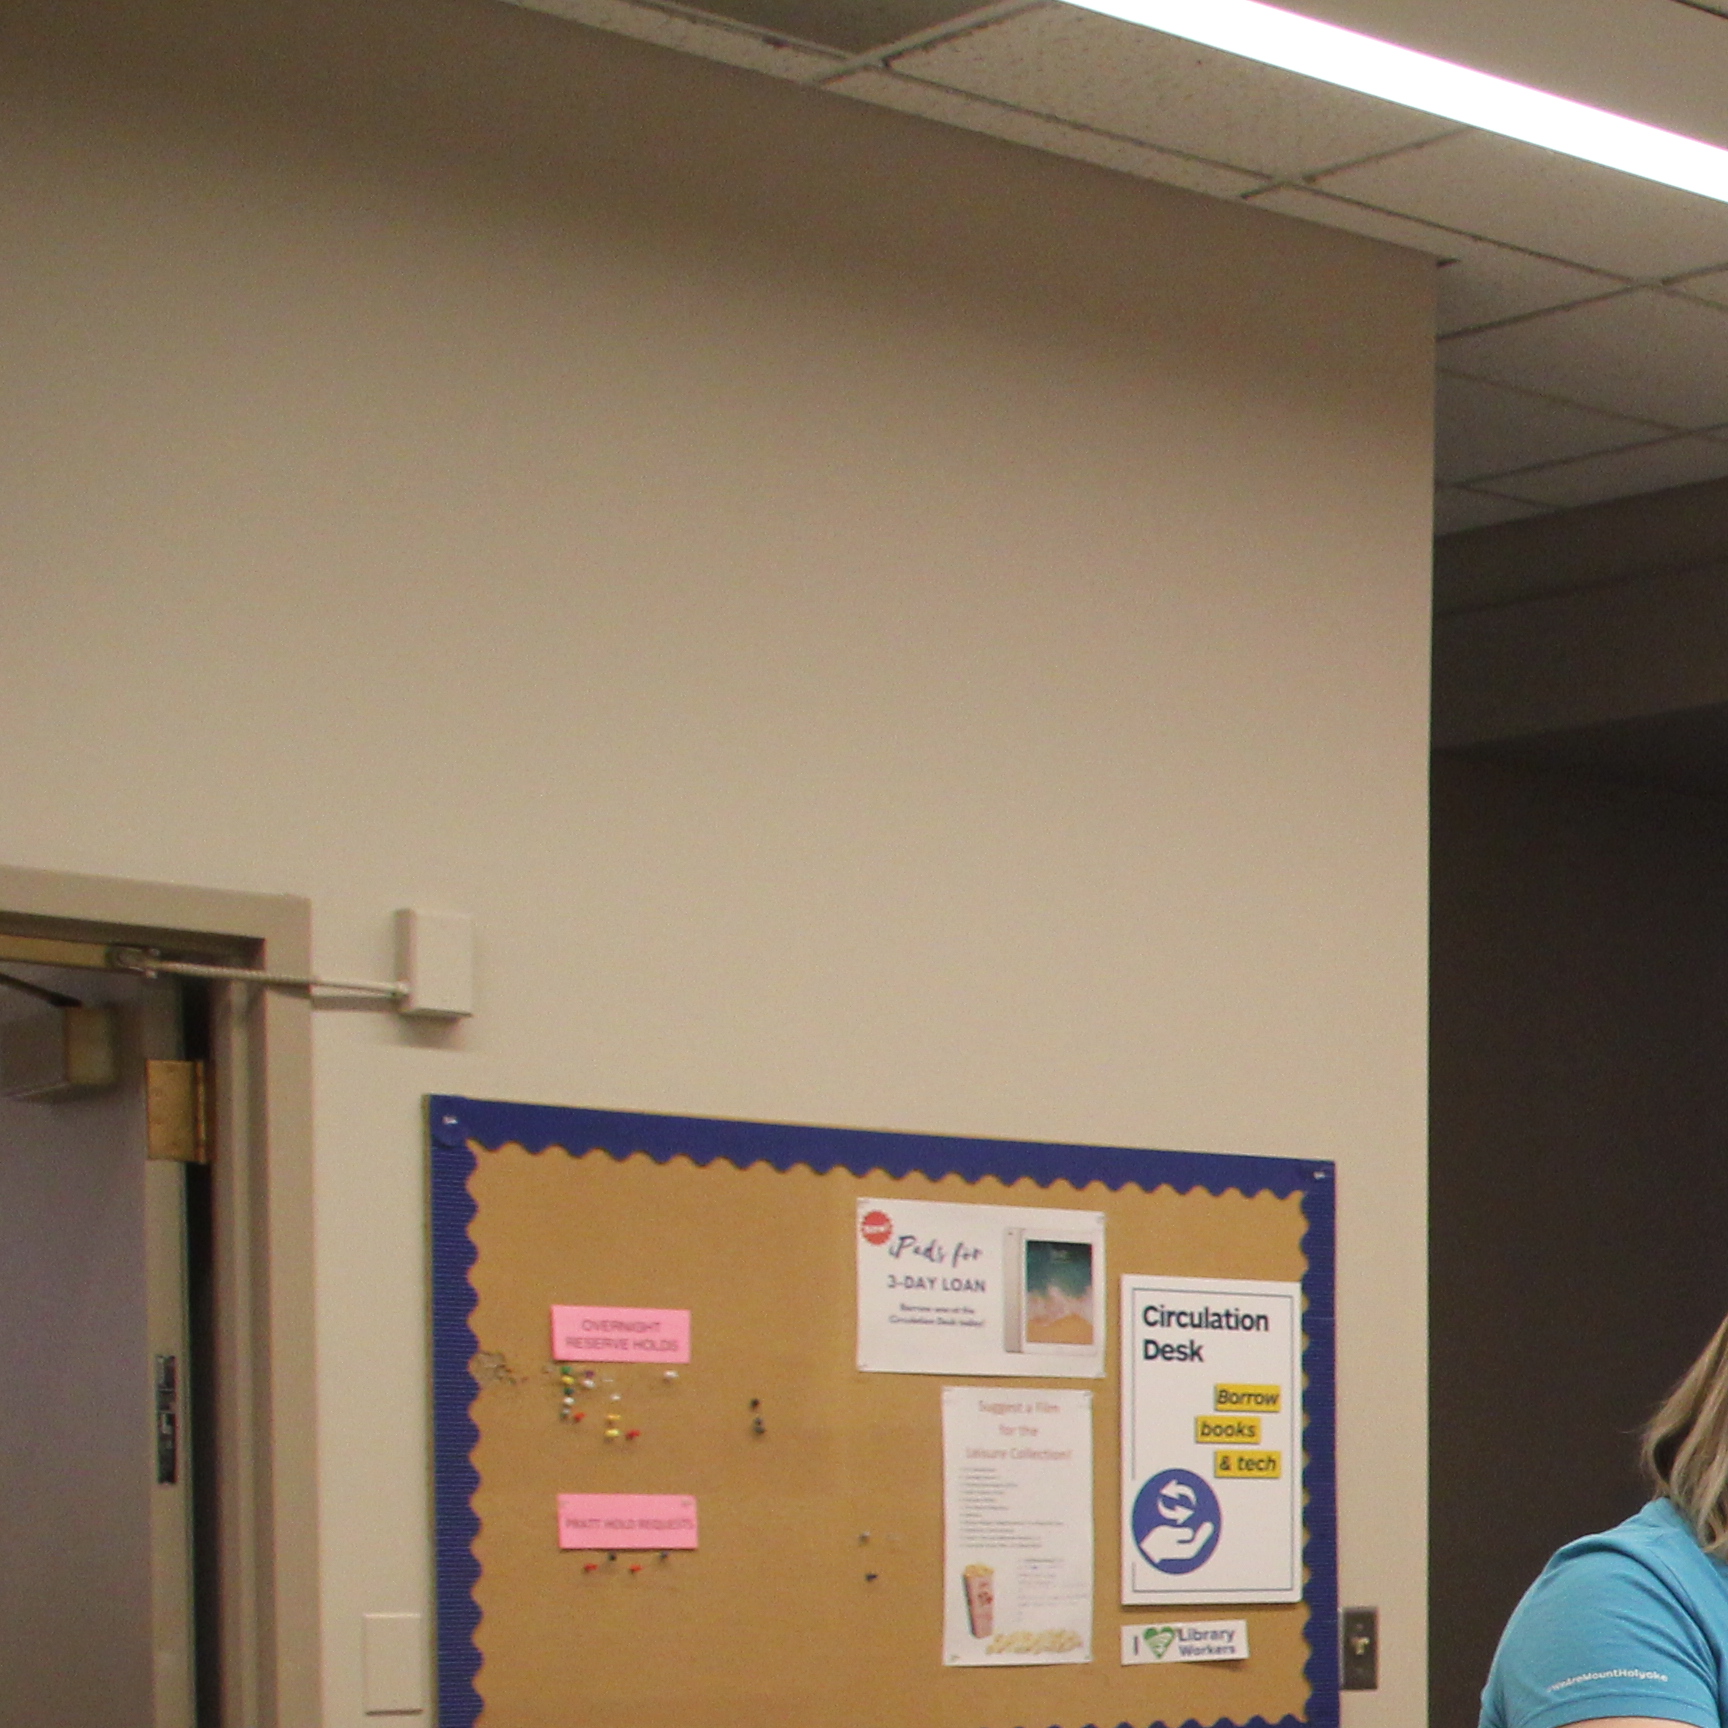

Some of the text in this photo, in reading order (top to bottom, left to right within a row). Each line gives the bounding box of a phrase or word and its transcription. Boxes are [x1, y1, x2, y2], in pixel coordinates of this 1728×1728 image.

[951, 1242, 983, 1268] for
[887, 1274, 986, 1293] 3-DAY LOAN
[1142, 1305, 1269, 1332] Circulation
[1143, 1339, 1204, 1362] Desk
[1217, 1388, 1280, 1405] Borrow
[1200, 1421, 1257, 1437] books
[1219, 1456, 1277, 1471] & tech
[1177, 1628, 1235, 1643] Library
[1179, 1645, 1235, 1657] Workers
